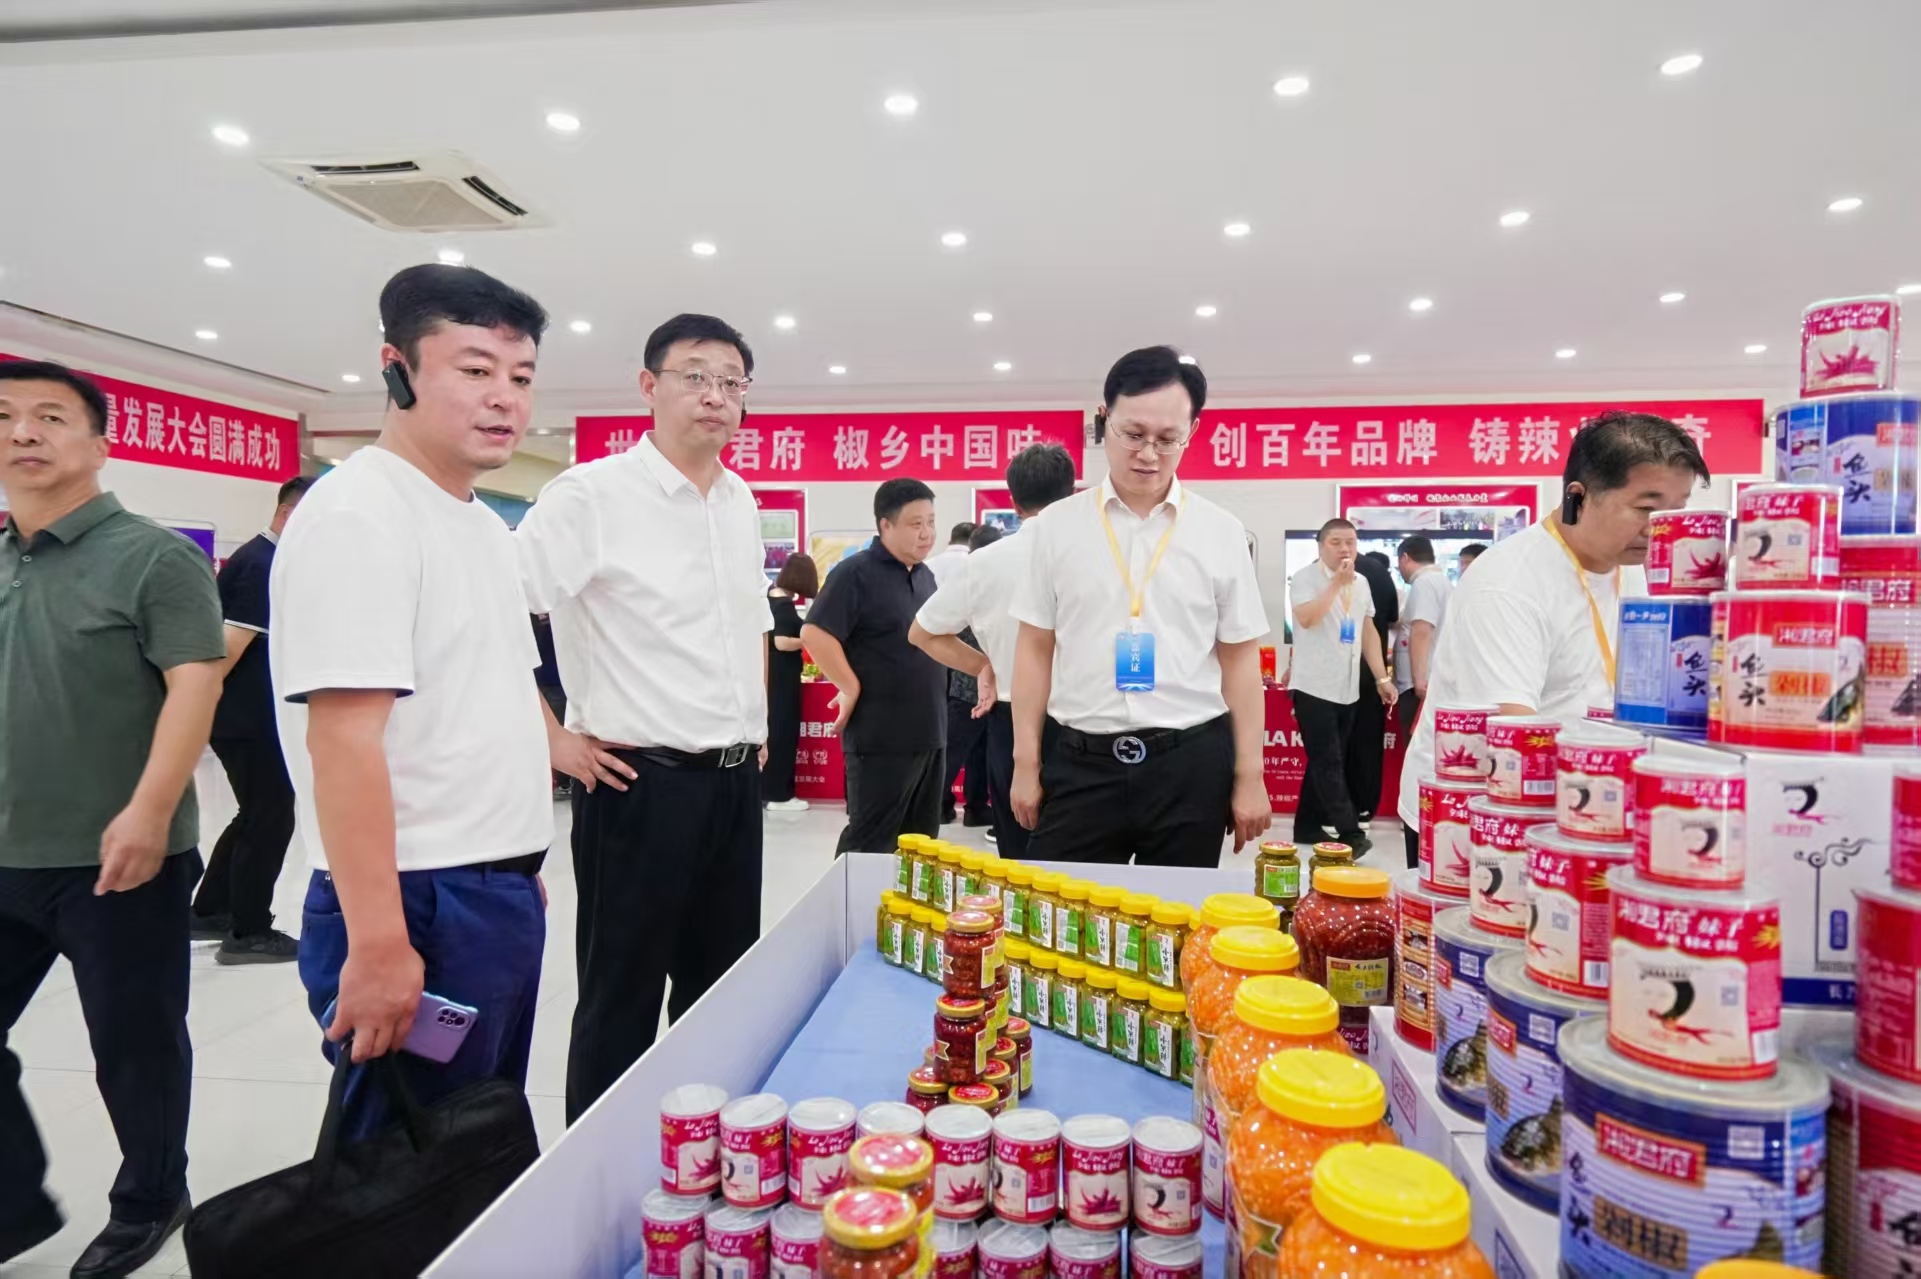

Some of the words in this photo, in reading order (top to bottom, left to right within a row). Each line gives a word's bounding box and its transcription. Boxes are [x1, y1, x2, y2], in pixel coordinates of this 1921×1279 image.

[1210, 417, 1439, 468] 创百年品牌
[1469, 413, 1712, 466] 铸辣奇
[1603, 1123, 1693, 1179] 湘君府
